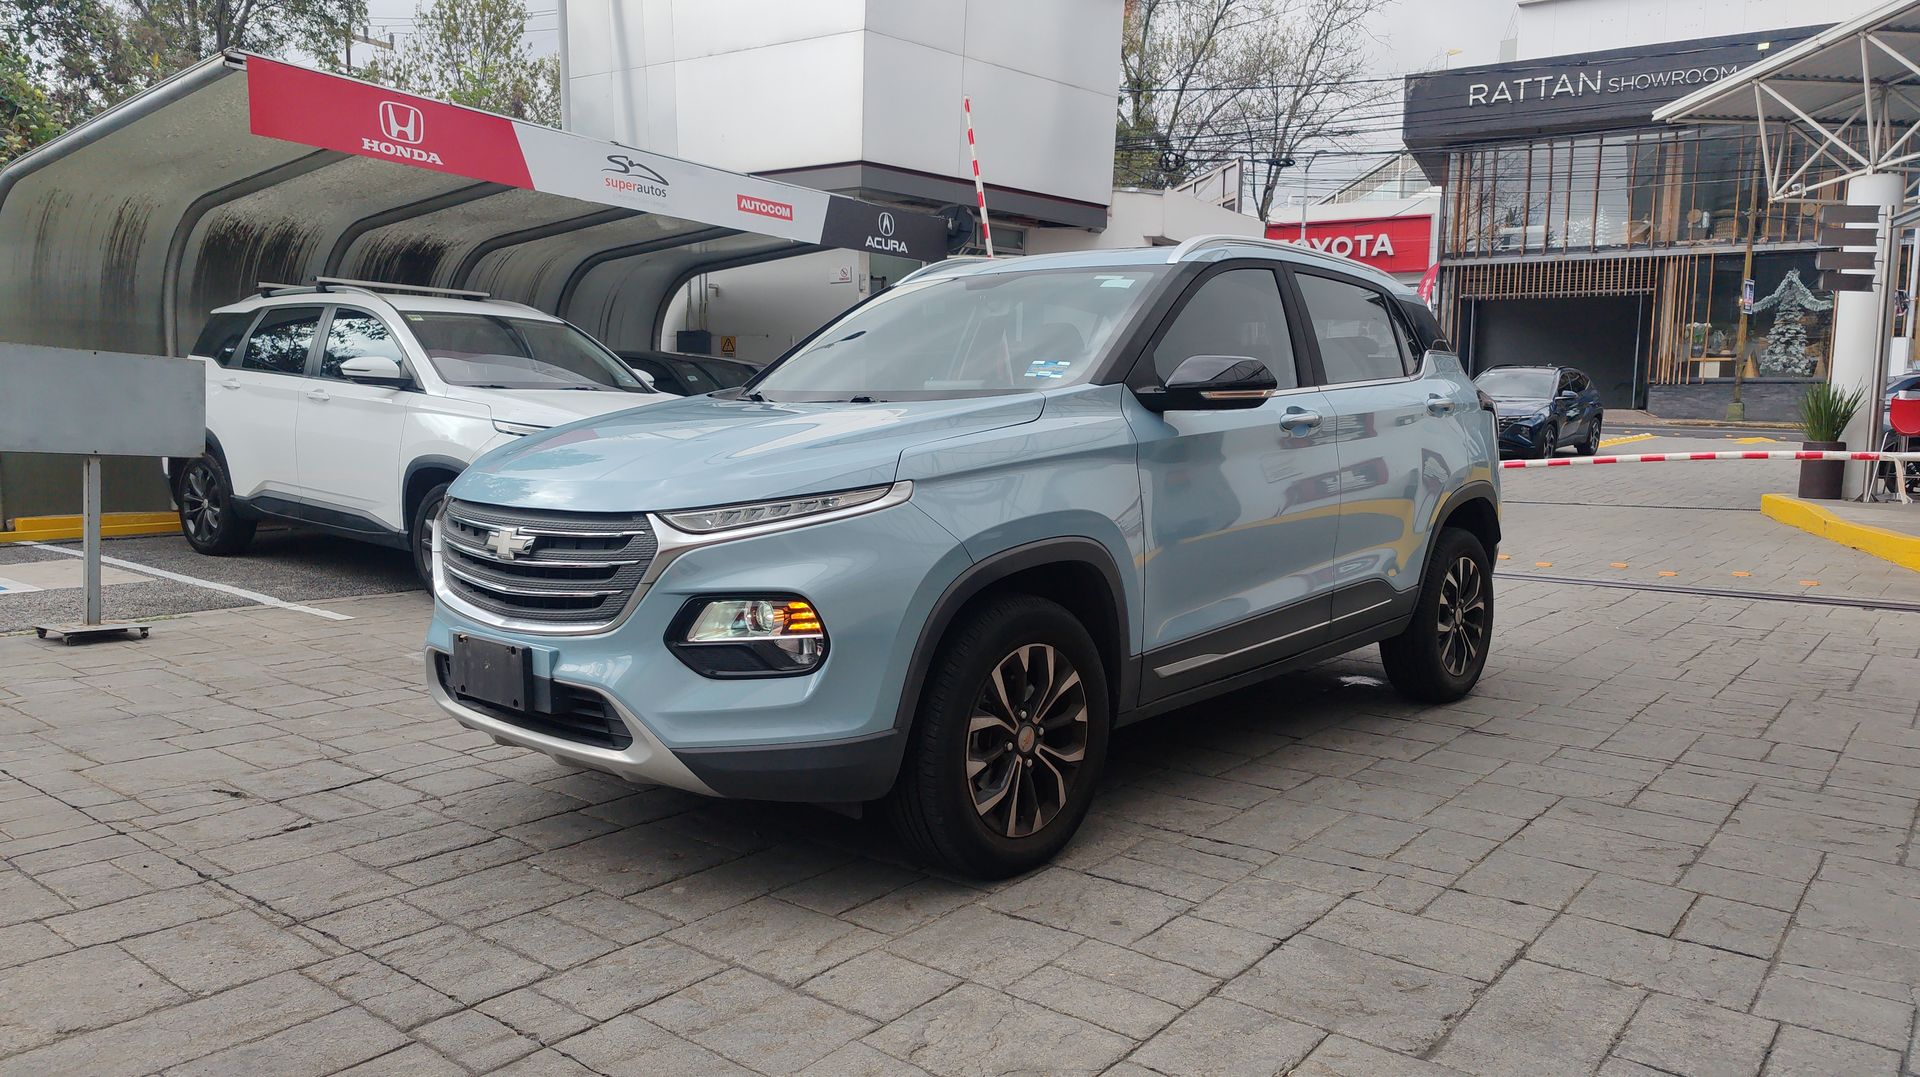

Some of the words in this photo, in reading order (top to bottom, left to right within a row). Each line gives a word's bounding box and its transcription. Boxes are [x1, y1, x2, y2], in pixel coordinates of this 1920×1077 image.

[1468, 70, 1602, 106] RATTAN
[1607, 64, 1738, 93] SHOWROOM
[361, 137, 444, 165] HONDA
[605, 177, 667, 198] superautos
[740, 198, 791, 217] AUTOCOM
[865, 235, 909, 254] ACURA
[1275, 233, 1394, 258] YOTA
